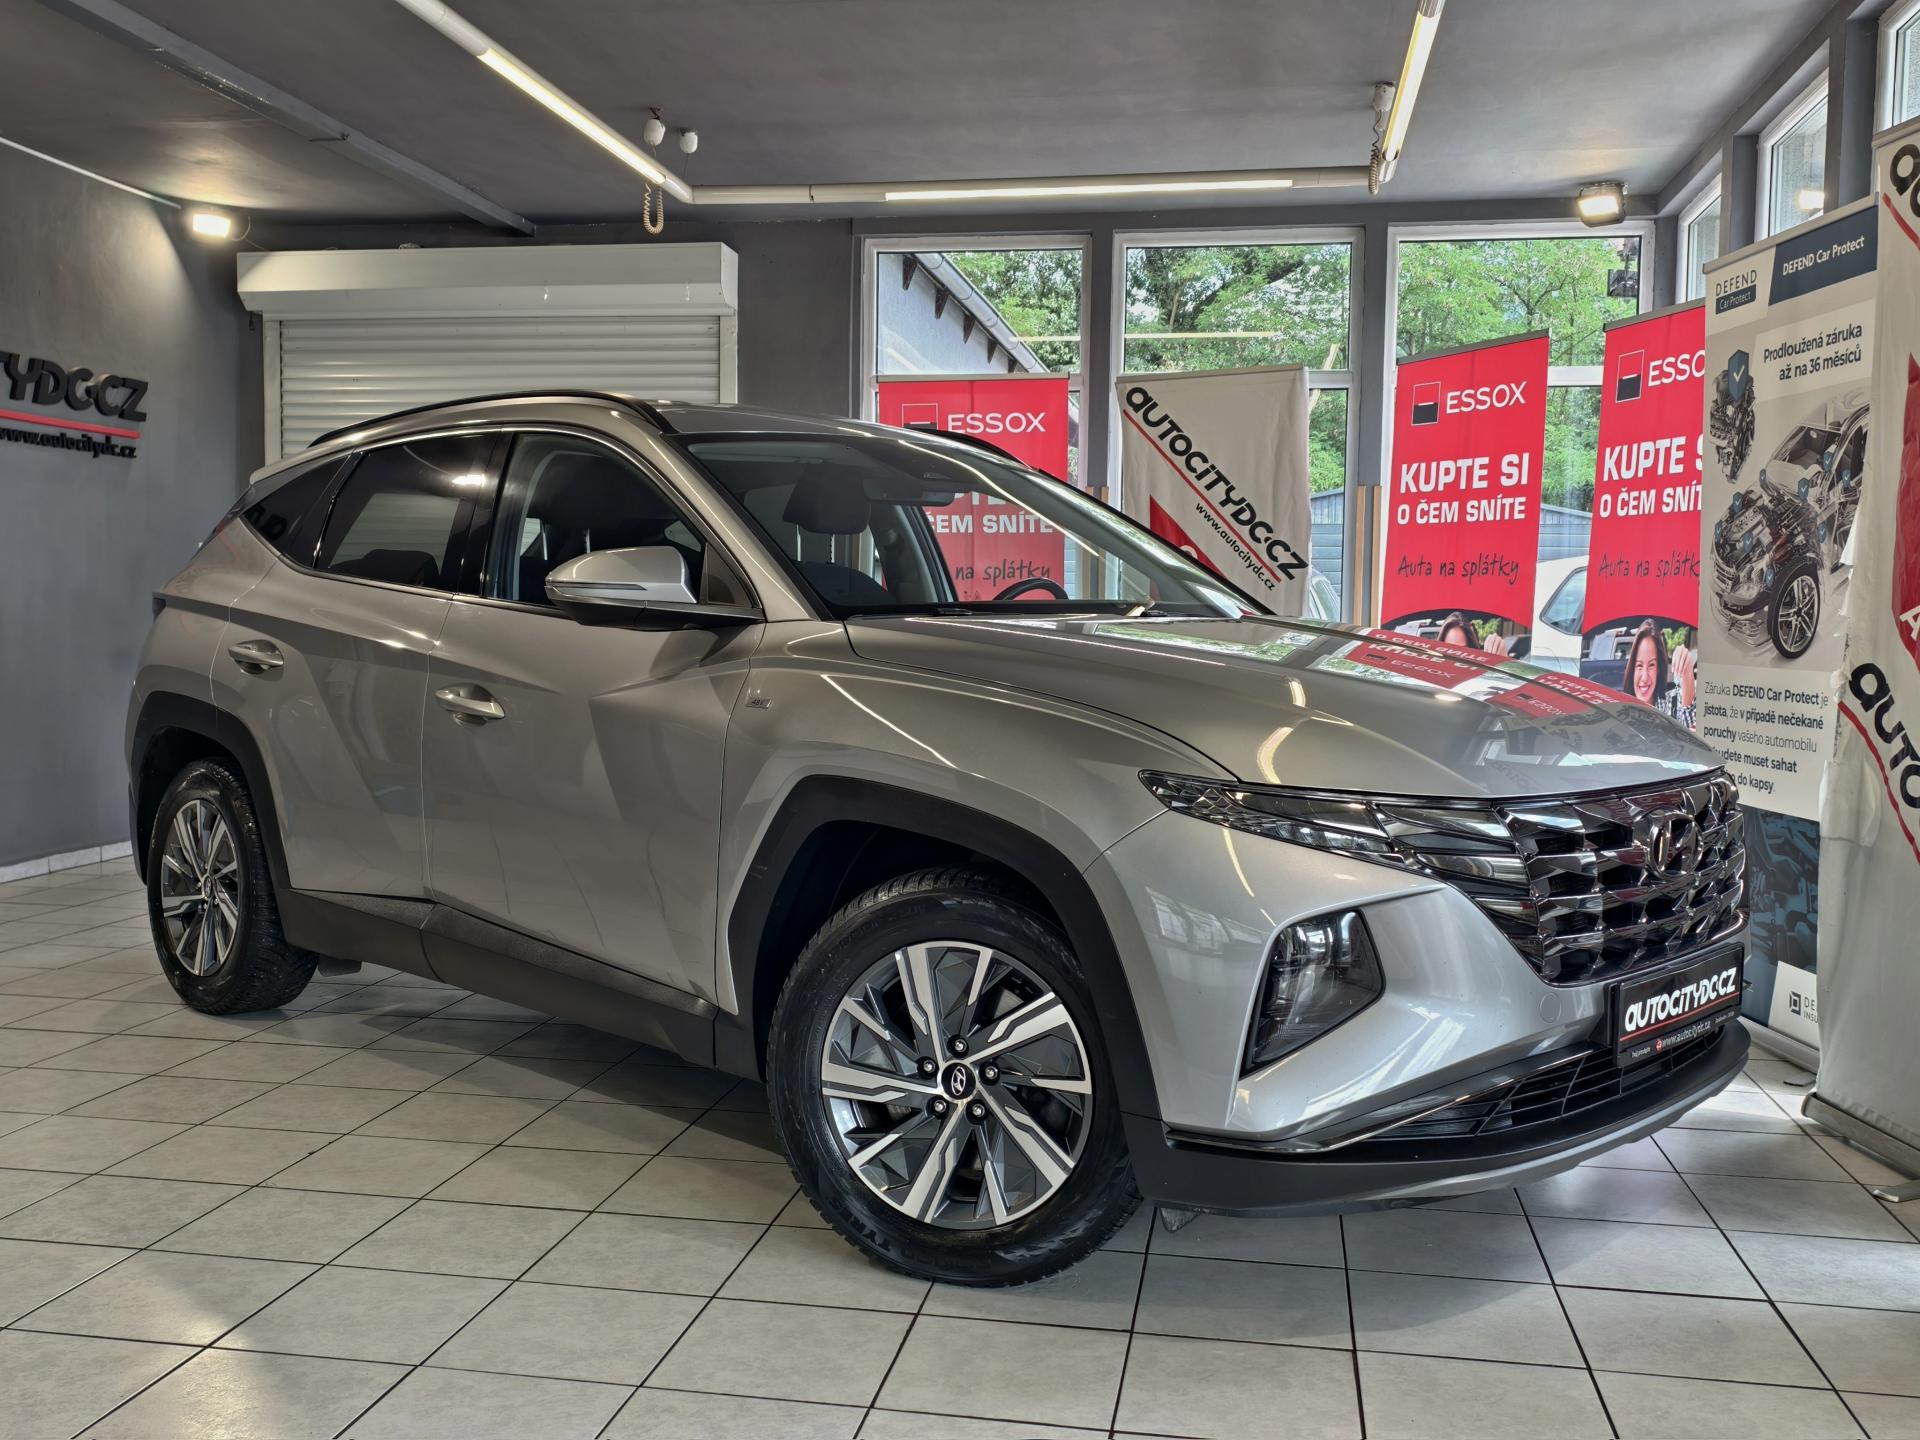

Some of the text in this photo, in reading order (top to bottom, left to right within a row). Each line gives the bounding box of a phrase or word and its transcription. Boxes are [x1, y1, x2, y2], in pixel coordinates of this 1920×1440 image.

[1783, 235, 1865, 276] DEFEND Car Protect
[1716, 269, 1757, 297] DEFEND
[1719, 291, 1751, 310] Car Protect
[1764, 324, 1862, 363] Prodloužená záruka
[1779, 344, 1862, 381] až na 36 měsíců
[1446, 381, 1528, 414] ESSOX
[947, 412, 1047, 434] ESSOX
[1603, 435, 1687, 482] KUPTE
[1400, 452, 1530, 494] KUPTE SI
[1397, 493, 1527, 525] O ČEM SNÍTE
[1599, 493, 1612, 518] O
[1616, 487, 1657, 517] ČEM
[982, 510, 1054, 533] SNÍTE
[1194, 502, 1276, 592] www.autocitydc.cz
[955, 565, 974, 580] na
[1398, 552, 1519, 585] Auta na splátky
[1598, 552, 1630, 579] Auta
[1635, 560, 1650, 577] na
[1704, 681, 1829, 709] Záruka DEFEND Car Protect je
[1730, 705, 1739, 719] že
[1740, 710, 1745, 719] v
[1746, 708, 1776, 724] případě
[1778, 712, 1824, 730] nečekané
[1703, 726, 1817, 753] poruchy vašeho automobilu
[1743, 756, 1769, 769] muset
[1771, 757, 1798, 773] sahat
[1738, 773, 1748, 786] do
